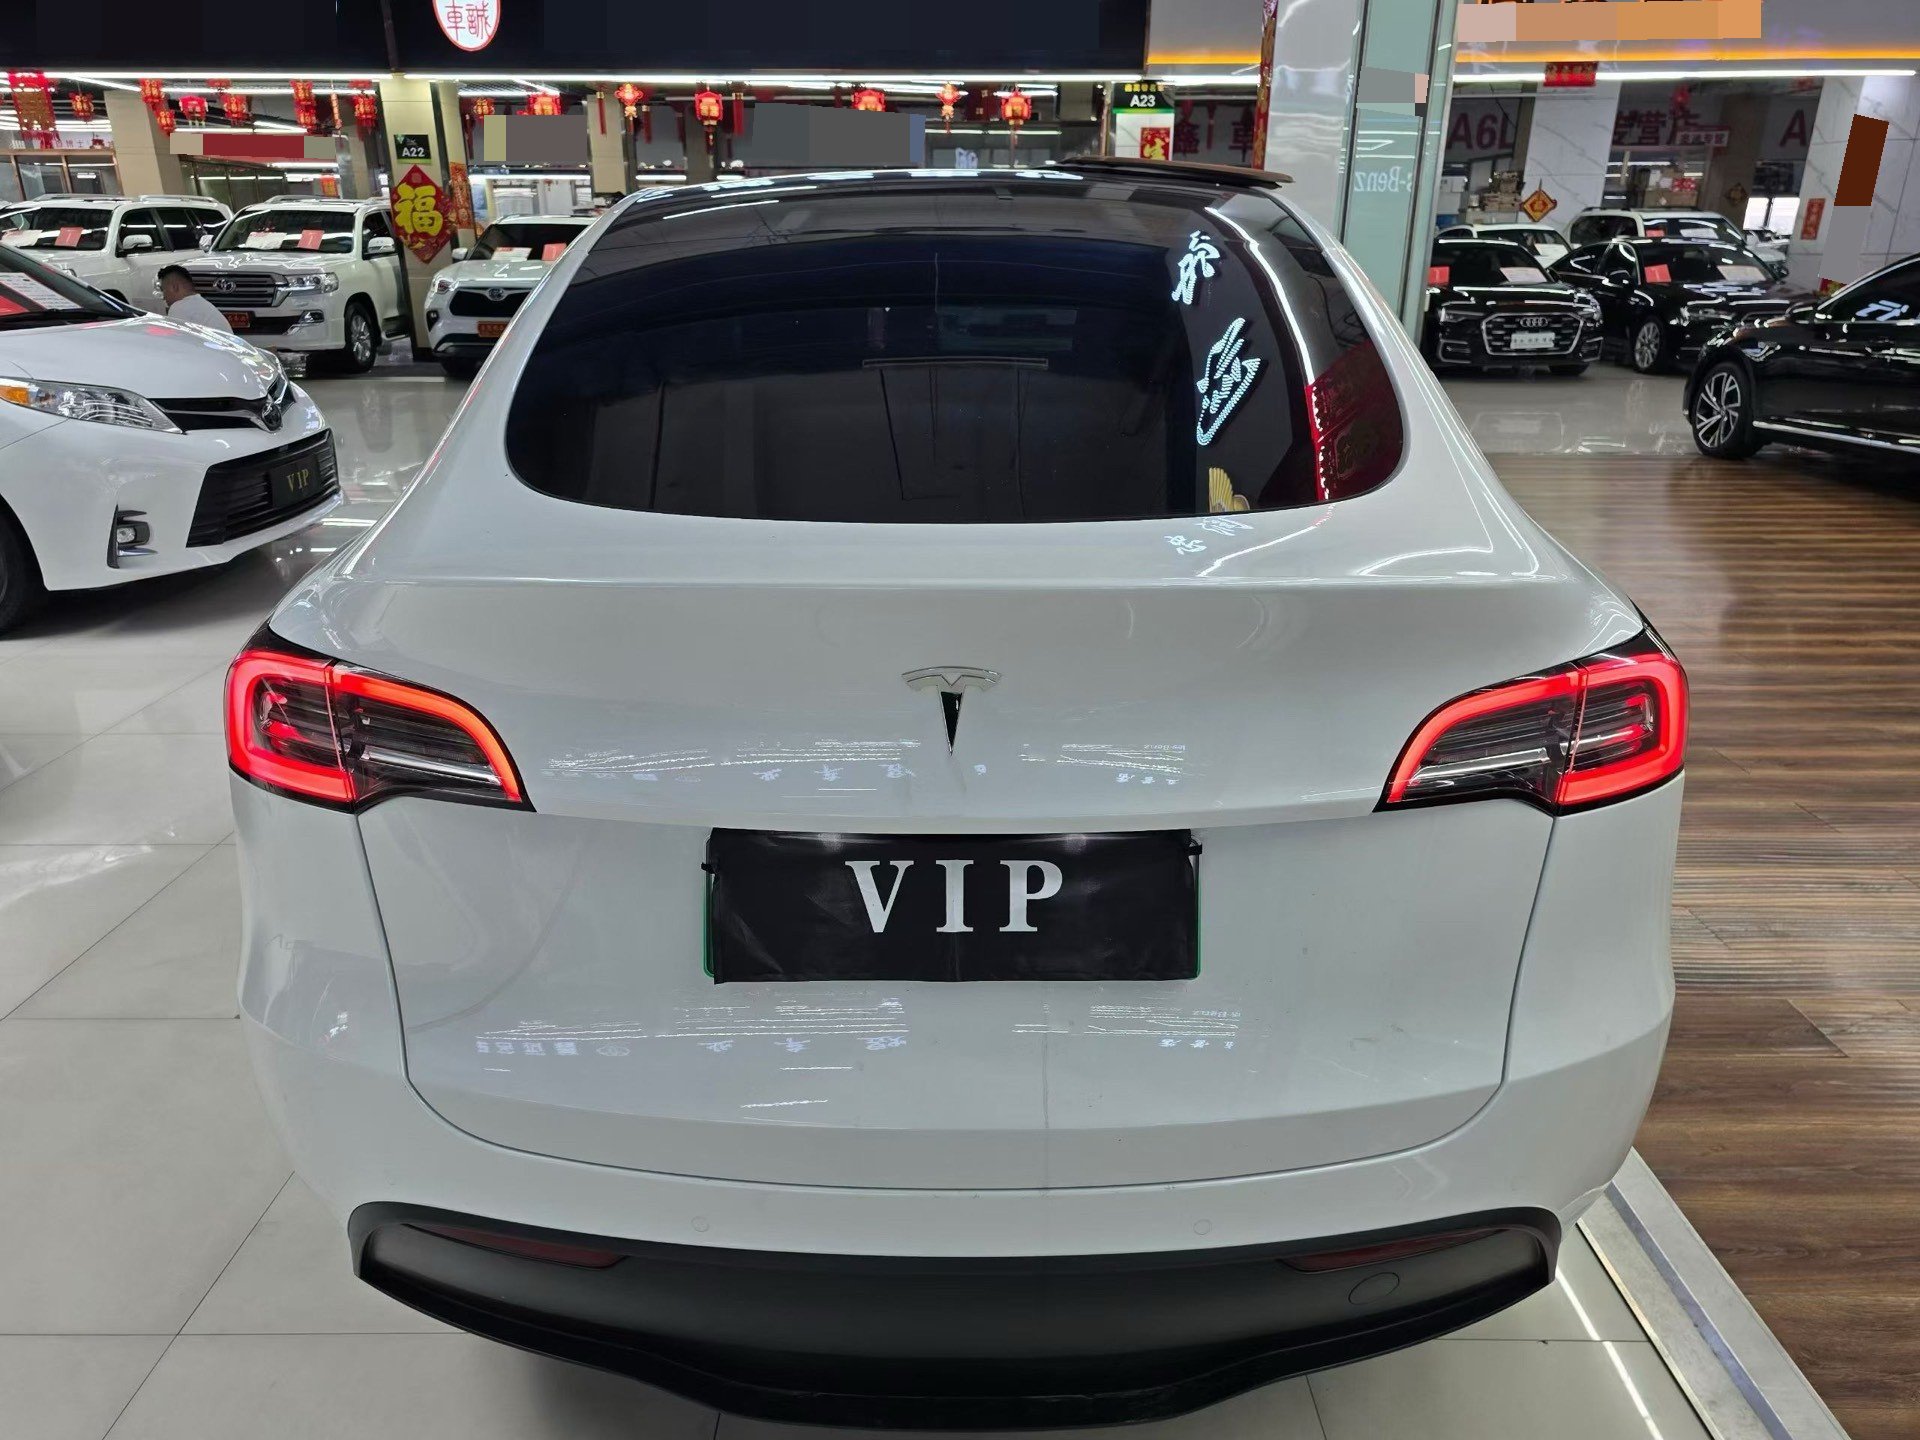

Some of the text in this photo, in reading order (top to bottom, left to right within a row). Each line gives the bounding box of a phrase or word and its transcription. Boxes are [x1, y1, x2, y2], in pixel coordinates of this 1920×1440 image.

[1130, 94, 1156, 107] A23
[1446, 112, 1514, 150] A6L
[402, 147, 425, 157] A22
[394, 182, 443, 236] 福
[286, 469, 309, 492] VIP
[844, 859, 1065, 933] VIP
